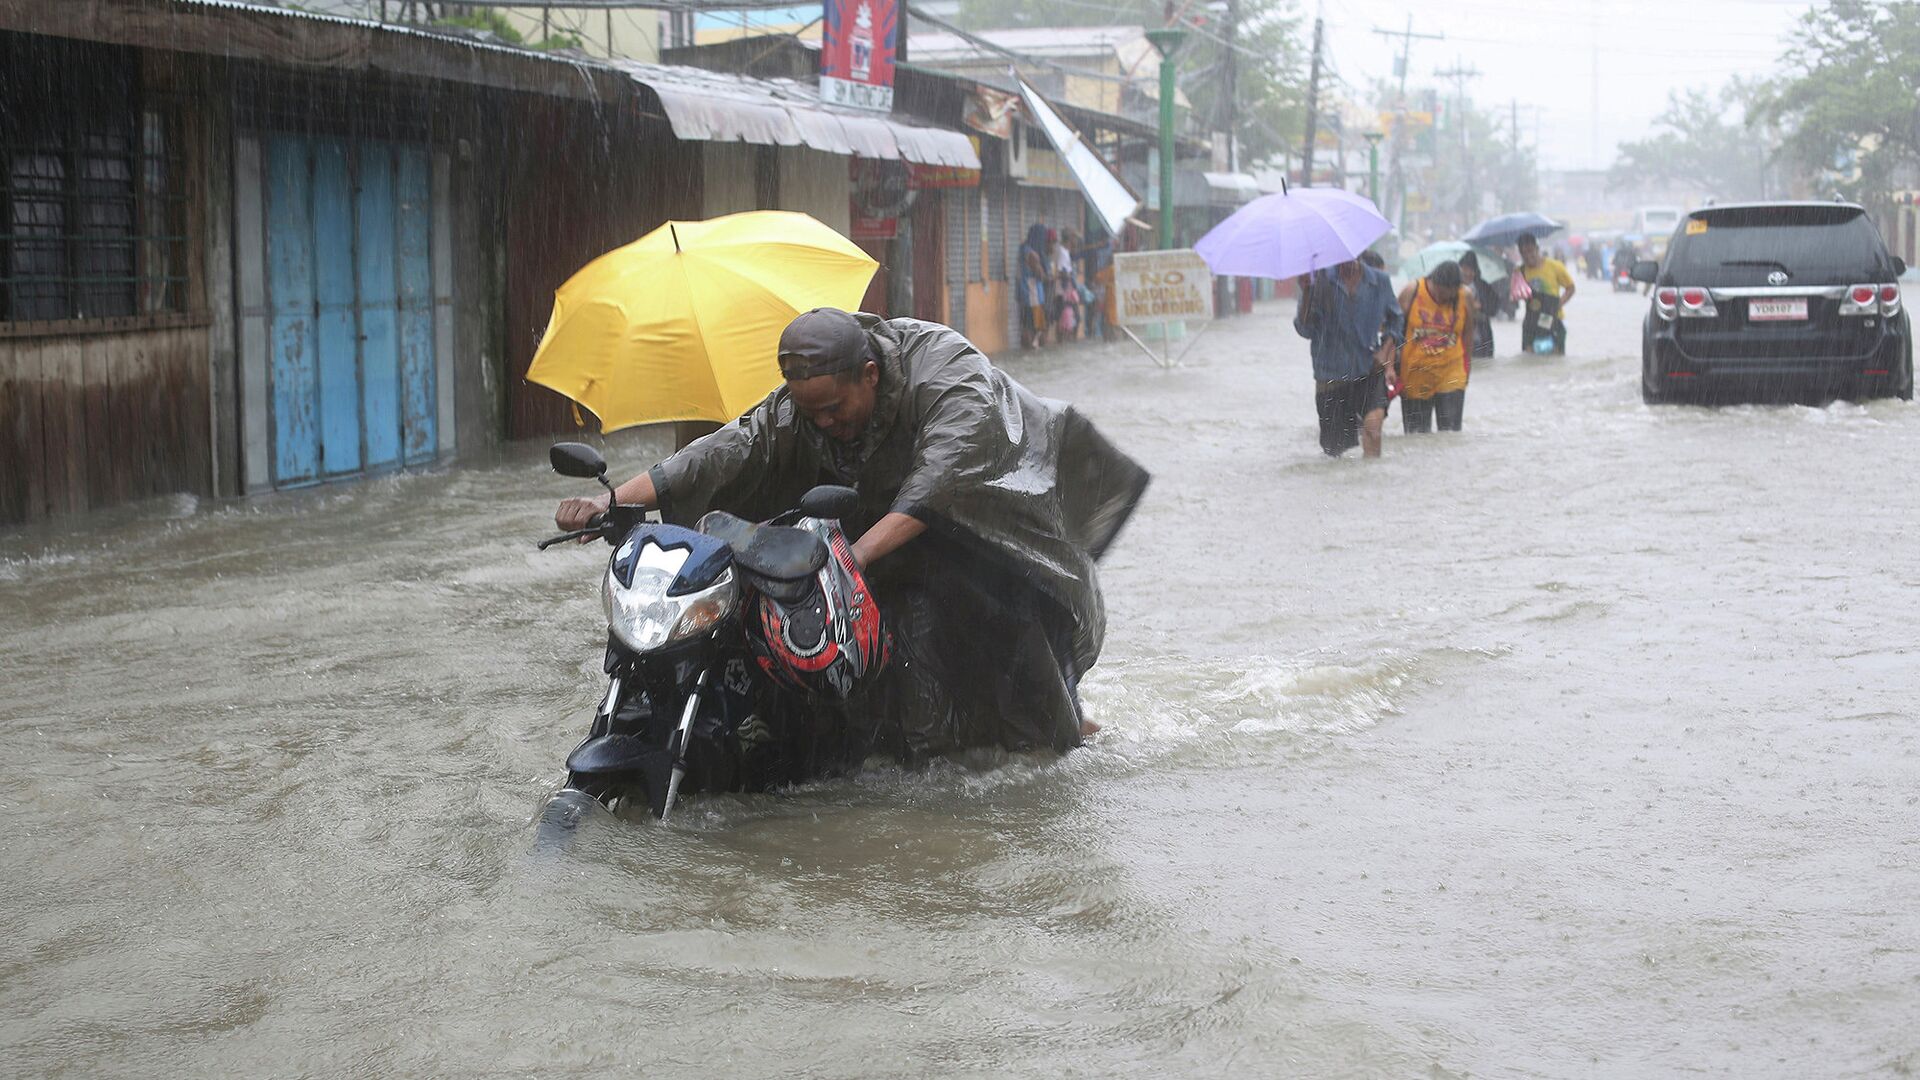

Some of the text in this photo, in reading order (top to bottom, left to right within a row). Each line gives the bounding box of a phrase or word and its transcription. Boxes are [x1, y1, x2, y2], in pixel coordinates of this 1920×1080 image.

[1140, 271, 1184, 286] NO
[1123, 286, 1184, 302] LOADING
[1124, 300, 1204, 317] UNLOADING
